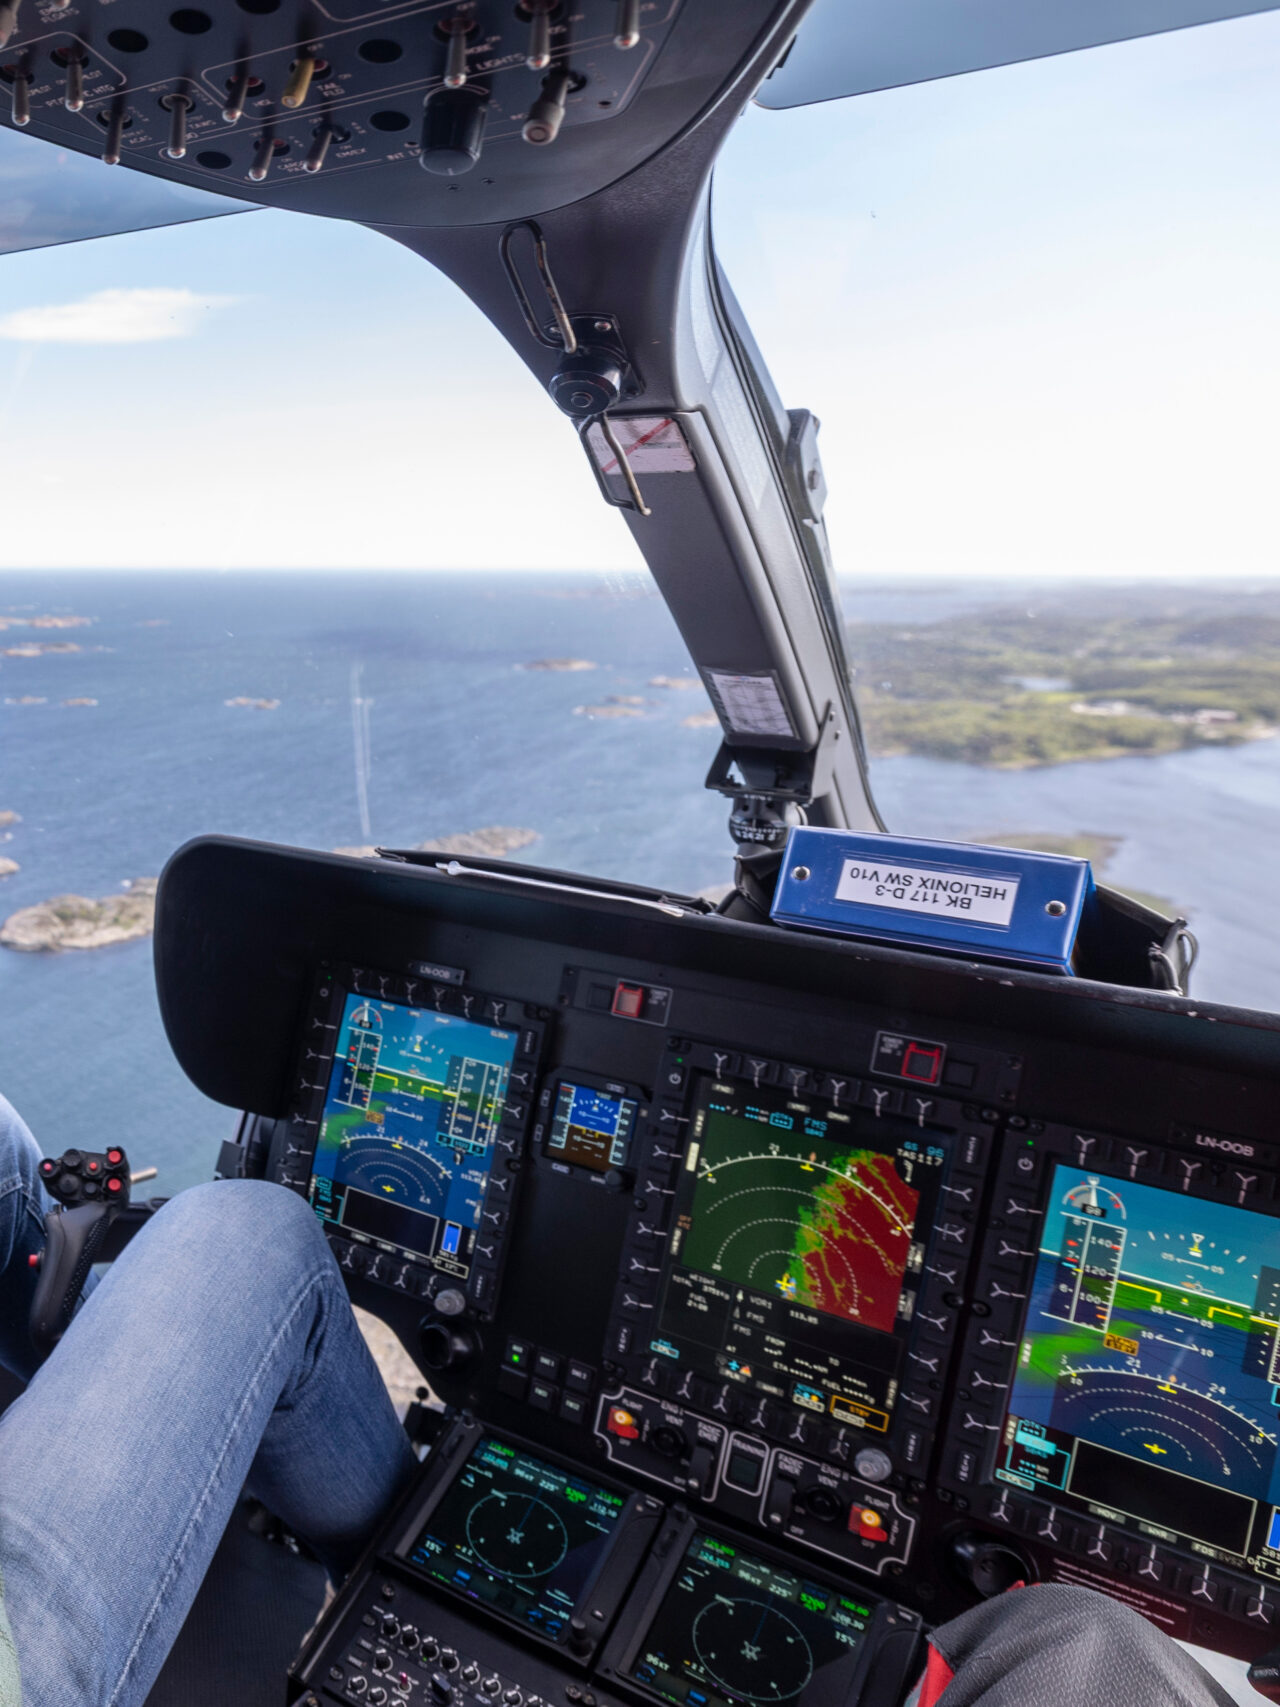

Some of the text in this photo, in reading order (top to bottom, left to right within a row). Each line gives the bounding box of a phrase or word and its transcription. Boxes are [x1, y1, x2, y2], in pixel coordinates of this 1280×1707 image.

[851, 868, 1007, 901] HELIONIX SW V10
[875, 884, 971, 910] BK 117 D-3
[803, 1117, 828, 1131] FMS
[904, 1142, 944, 1158] GS 96
[1195, 1134, 1255, 1157] LN-OOB
[1090, 1236, 1113, 1248] 140
[1084, 1265, 1107, 1277] 120
[1079, 1292, 1102, 1305] 100
[746, 1311, 765, 1324] FMS
[732, 1323, 752, 1336] FMS
[1141, 1330, 1155, 1340] 10
[1200, 1347, 1214, 1358] 10
[1125, 1356, 1141, 1369] 21
[1208, 1383, 1226, 1396] 24
[1195, 1544, 1215, 1556] FDS
[1247, 1556, 1267, 1569] OAT
